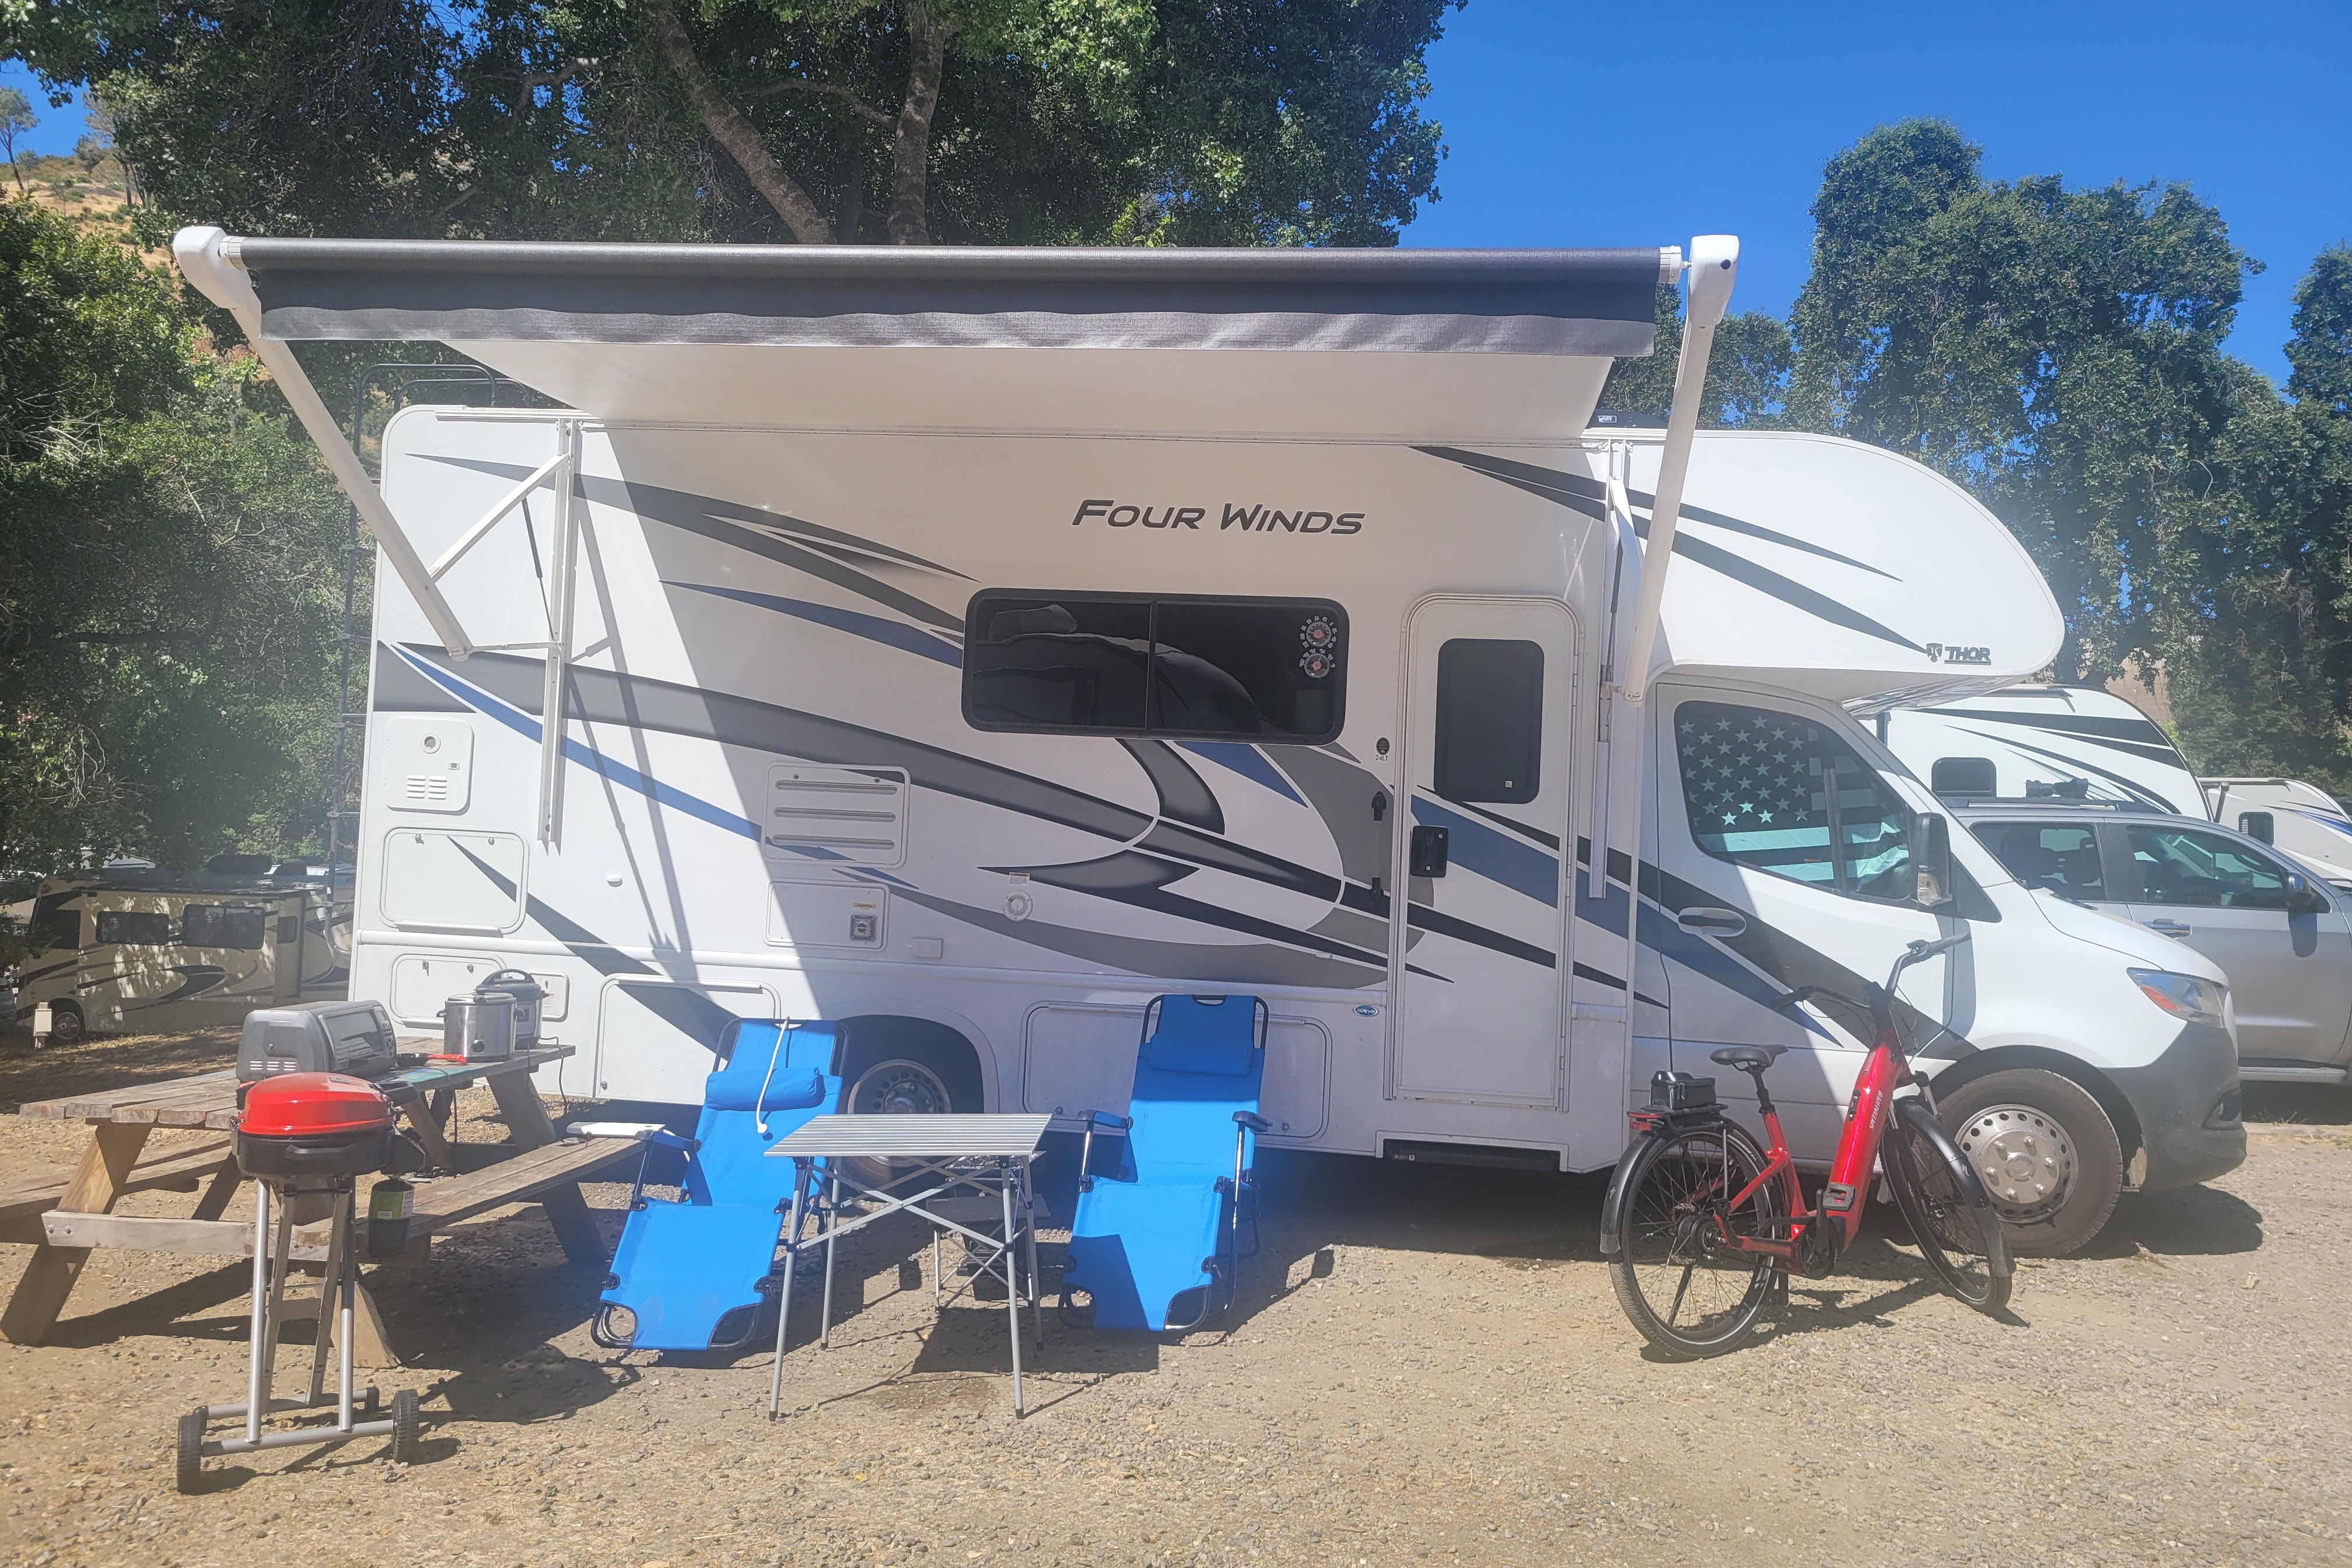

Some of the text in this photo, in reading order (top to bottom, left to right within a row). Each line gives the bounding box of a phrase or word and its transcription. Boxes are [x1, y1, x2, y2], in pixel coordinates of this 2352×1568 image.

[1072, 499, 1366, 535] FOUR WINDS
[1944, 646, 1990, 663] THOR
